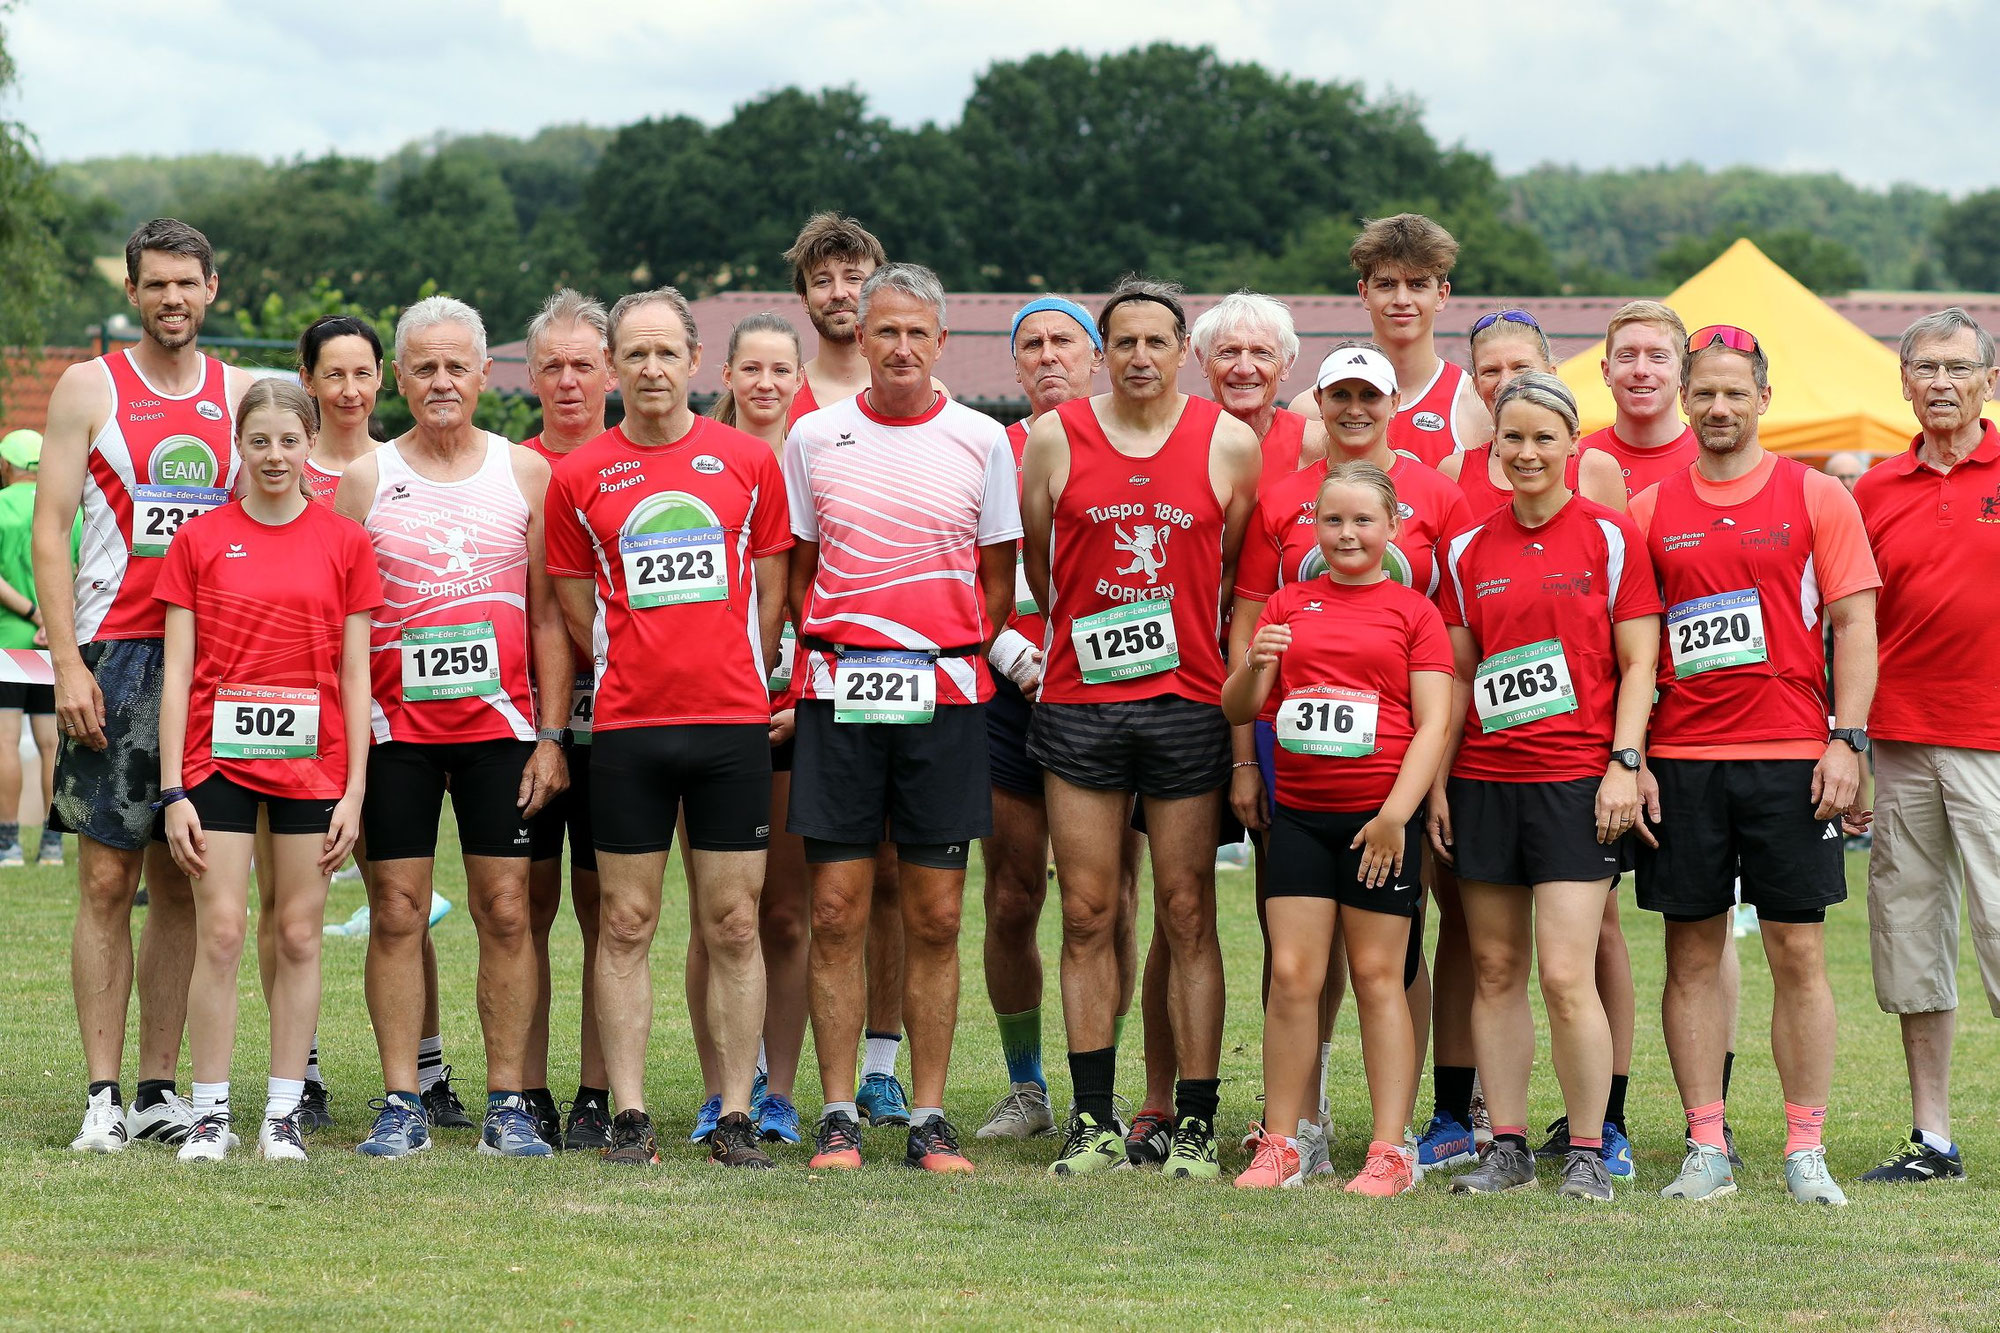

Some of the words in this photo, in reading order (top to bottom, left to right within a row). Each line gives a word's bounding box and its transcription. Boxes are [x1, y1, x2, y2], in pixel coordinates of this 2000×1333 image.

[129, 399, 161, 410] TuSpo
[129, 411, 166, 422] Borken
[162, 461, 206, 480] EAM
[599, 459, 641, 478] TuSpo
[600, 473, 646, 493] Borken
[136, 489, 227, 502] Schwalm-Eder-Laufcup
[391, 492, 410, 500] erima
[1086, 503, 1145, 524] Tuspo
[1153, 502, 1194, 529] 1896
[624, 532, 722, 549] Schwalm-Eder-Laufcup
[1665, 540, 1701, 552] LAUFTREFF
[1682, 532, 1705, 540] Borken
[636, 550, 715, 585] 2323
[417, 575, 493, 597] BORKEN
[1095, 579, 1175, 602] BORKEN
[1074, 602, 1168, 629] Schwalm-Eder-Laufcup
[1668, 595, 1757, 620] Schwalm-Eder-Laufcup
[404, 627, 492, 641] Schwalm-Eder-Laufcup
[1086, 621, 1165, 660] 1258
[1679, 613, 1751, 654] 2320
[413, 644, 488, 677] 1259
[217, 688, 318, 701] Schwalm-Eder-Laufcup
[847, 672, 919, 702] 2321
[1483, 663, 1558, 706] 1263
[235, 706, 296, 737] 502
[1296, 703, 1354, 733] 316
[1433, 1136, 1470, 1160] BROOKS
